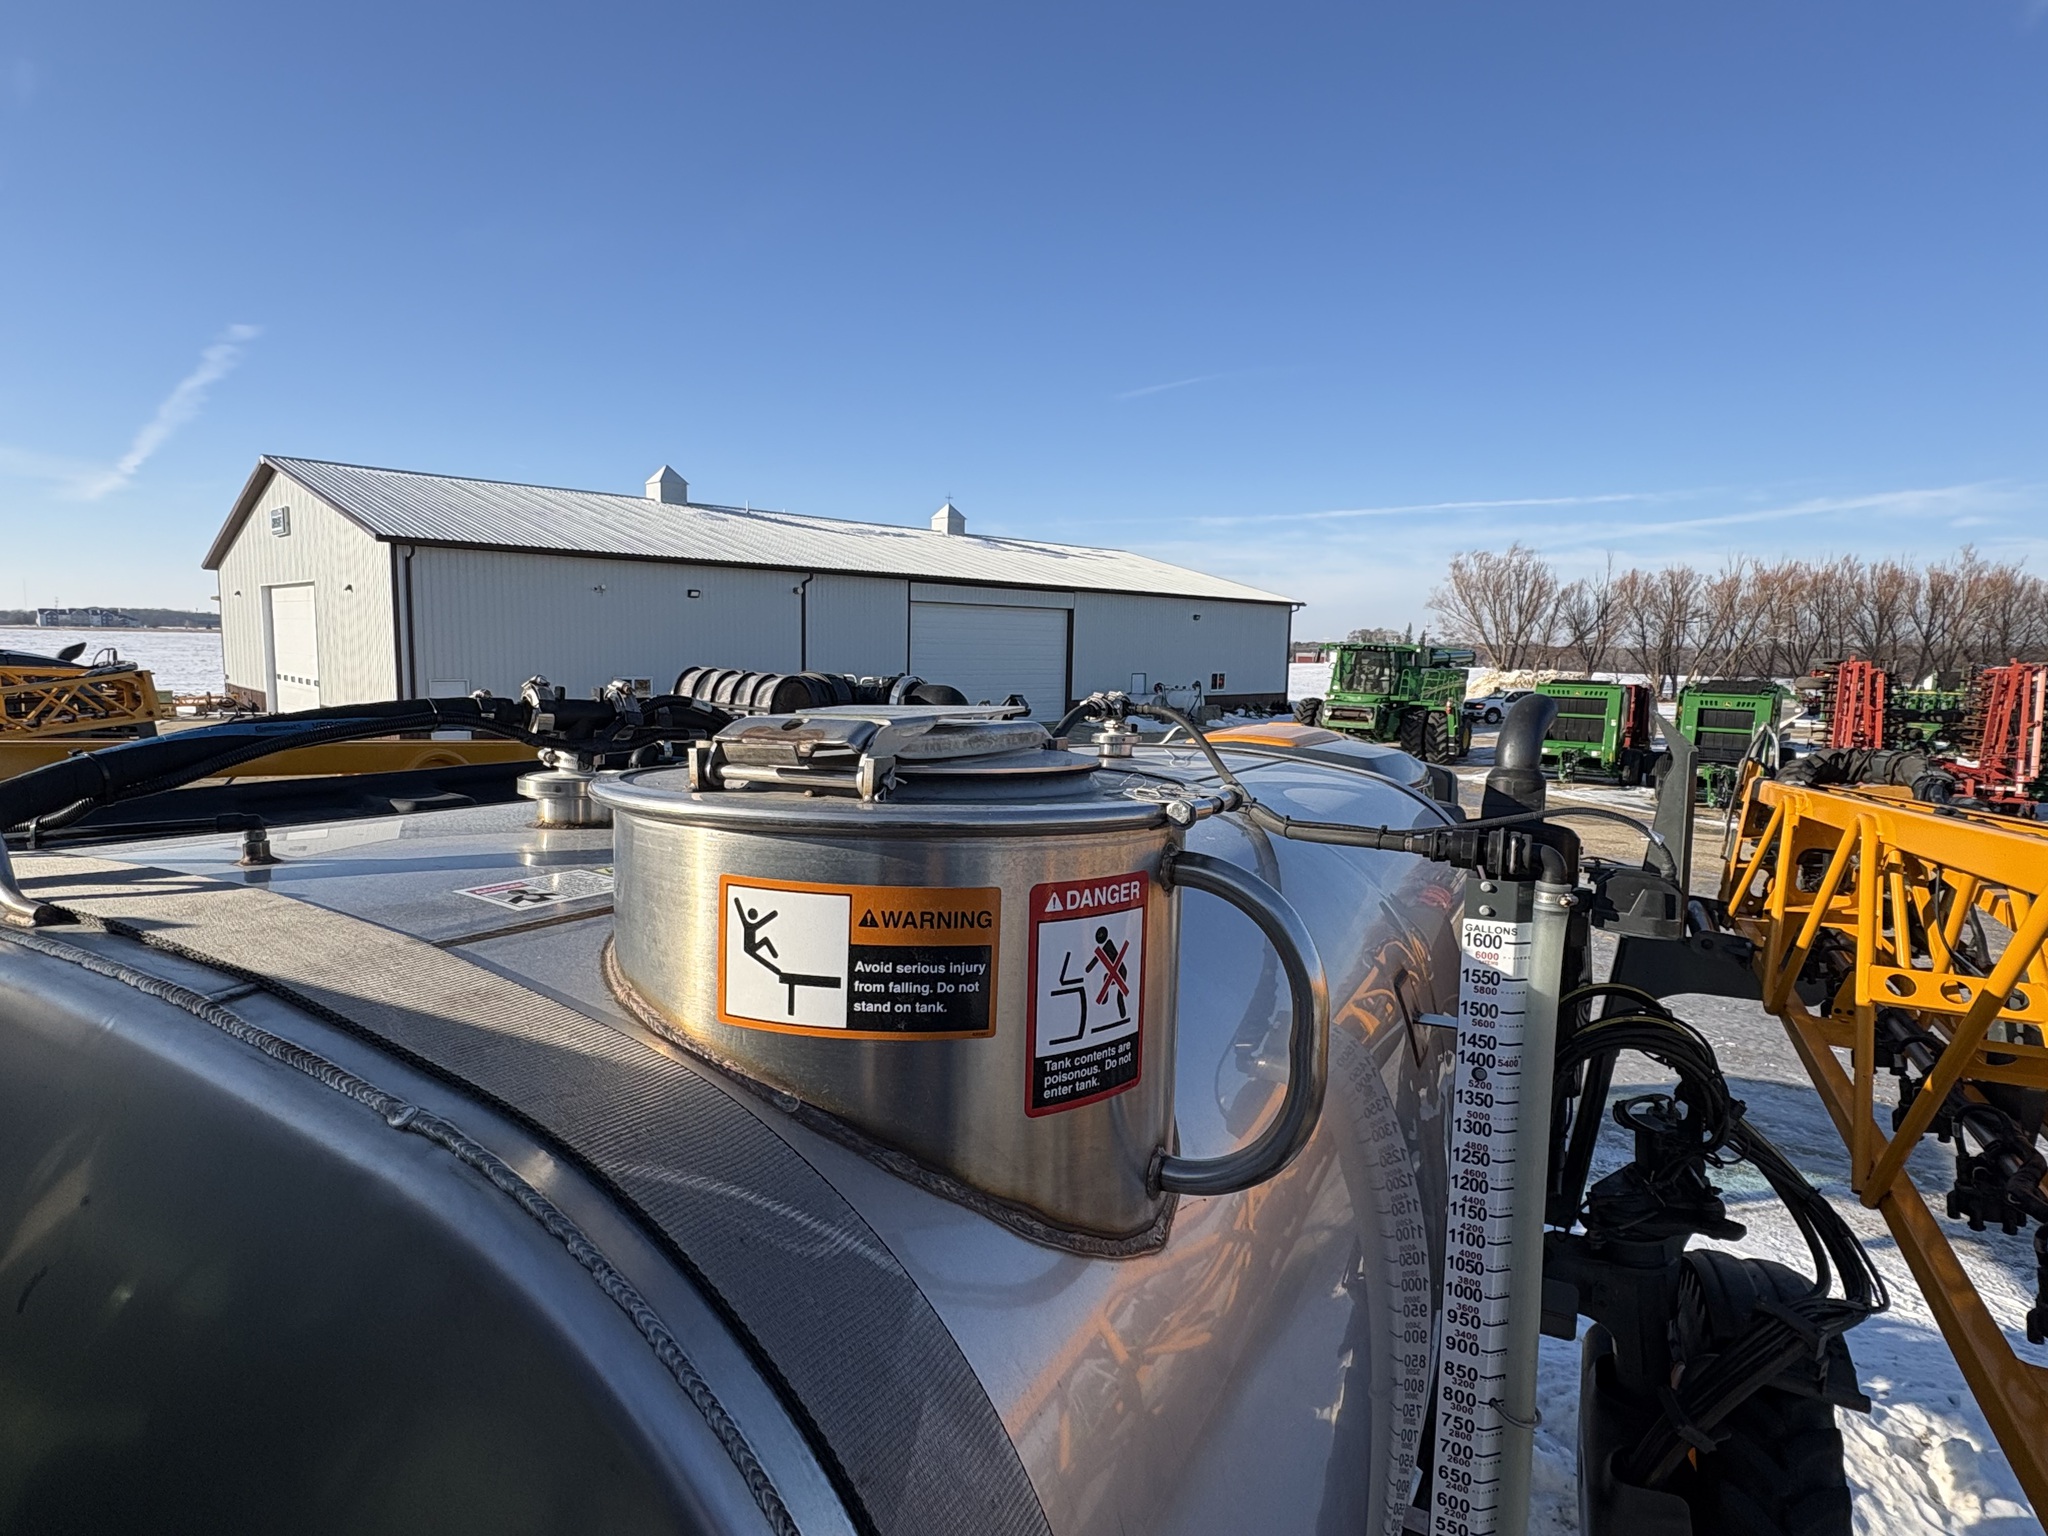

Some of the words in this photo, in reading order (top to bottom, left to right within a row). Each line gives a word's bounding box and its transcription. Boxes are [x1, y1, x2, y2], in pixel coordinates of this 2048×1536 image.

[1066, 880, 1140, 910] DANGER
[881, 910, 992, 929] WARNING
[1465, 924, 1518, 936] GALLONS
[1464, 932, 1502, 949] 1600
[1475, 951, 1499, 960] 6000
[854, 961, 892, 973] Avoid
[896, 962, 946, 974] serious
[950, 962, 986, 976] injury
[1462, 968, 1500, 986] 1550
[854, 980, 885, 993] from
[888, 981, 933, 996] falling.
[937, 982, 955, 993] Do
[958, 981, 980, 993] not
[1473, 986, 1498, 996] 5800
[853, 1001, 891, 1013] stand
[894, 1004, 912, 1013] on
[915, 1001, 947, 1013] tank.
[1460, 1001, 1499, 1019] 1500
[1471, 1019, 1496, 1029] 5600
[1459, 1032, 1497, 1050] 1450
[1044, 1058, 1072, 1072] Tank
[1074, 1046, 1116, 1067] contents
[1117, 1041, 1131, 1055] are
[1458, 1050, 1496, 1068] 1400
[1497, 1059, 1519, 1068] 5400
[1044, 1065, 1101, 1088] poisonous.
[1105, 1058, 1117, 1071] Do
[1118, 1052, 1132, 1067] not
[1043, 1083, 1074, 1099] enter
[1075, 1076, 1100, 1091] tank.
[1468, 1080, 1492, 1090] 5200
[1456, 1090, 1494, 1108] 1350
[1466, 1111, 1490, 1121] 5000
[1454, 1118, 1492, 1137] 1300
[1464, 1141, 1489, 1152] 4800
[1453, 1147, 1490, 1167] 1250
[1463, 1168, 1487, 1179] 4600
[1451, 1175, 1489, 1194] 1200
[1461, 1195, 1486, 1206] 4400
[1450, 1202, 1487, 1222] 1150
[1460, 1222, 1484, 1234] 4200
[1449, 1229, 1486, 1249] 1100
[1459, 1249, 1482, 1261] 4000
[1447, 1255, 1484, 1276] 1050
[1457, 1276, 1481, 1288] 3800
[1446, 1282, 1483, 1302] 1000
[1456, 1303, 1479, 1315] 3600
[1447, 1309, 1481, 1330] 950
[1454, 1329, 1478, 1341] 3400
[1445, 1336, 1480, 1356] 900
[1444, 1361, 1478, 1382] 850
[1451, 1377, 1475, 1390] 3200
[1443, 1387, 1477, 1407] 800
[1450, 1402, 1474, 1415] 3000
[1441, 1412, 1475, 1433] 750
[1449, 1429, 1472, 1441] 2800
[1440, 1438, 1474, 1460] 700
[1447, 1455, 1471, 1467] 2600
[1438, 1465, 1472, 1486] 650
[1445, 1480, 1469, 1494] 2400
[1437, 1491, 1470, 1514] 600
[1444, 1507, 1467, 1521] 2200
[1435, 1516, 1469, 1536] 550
